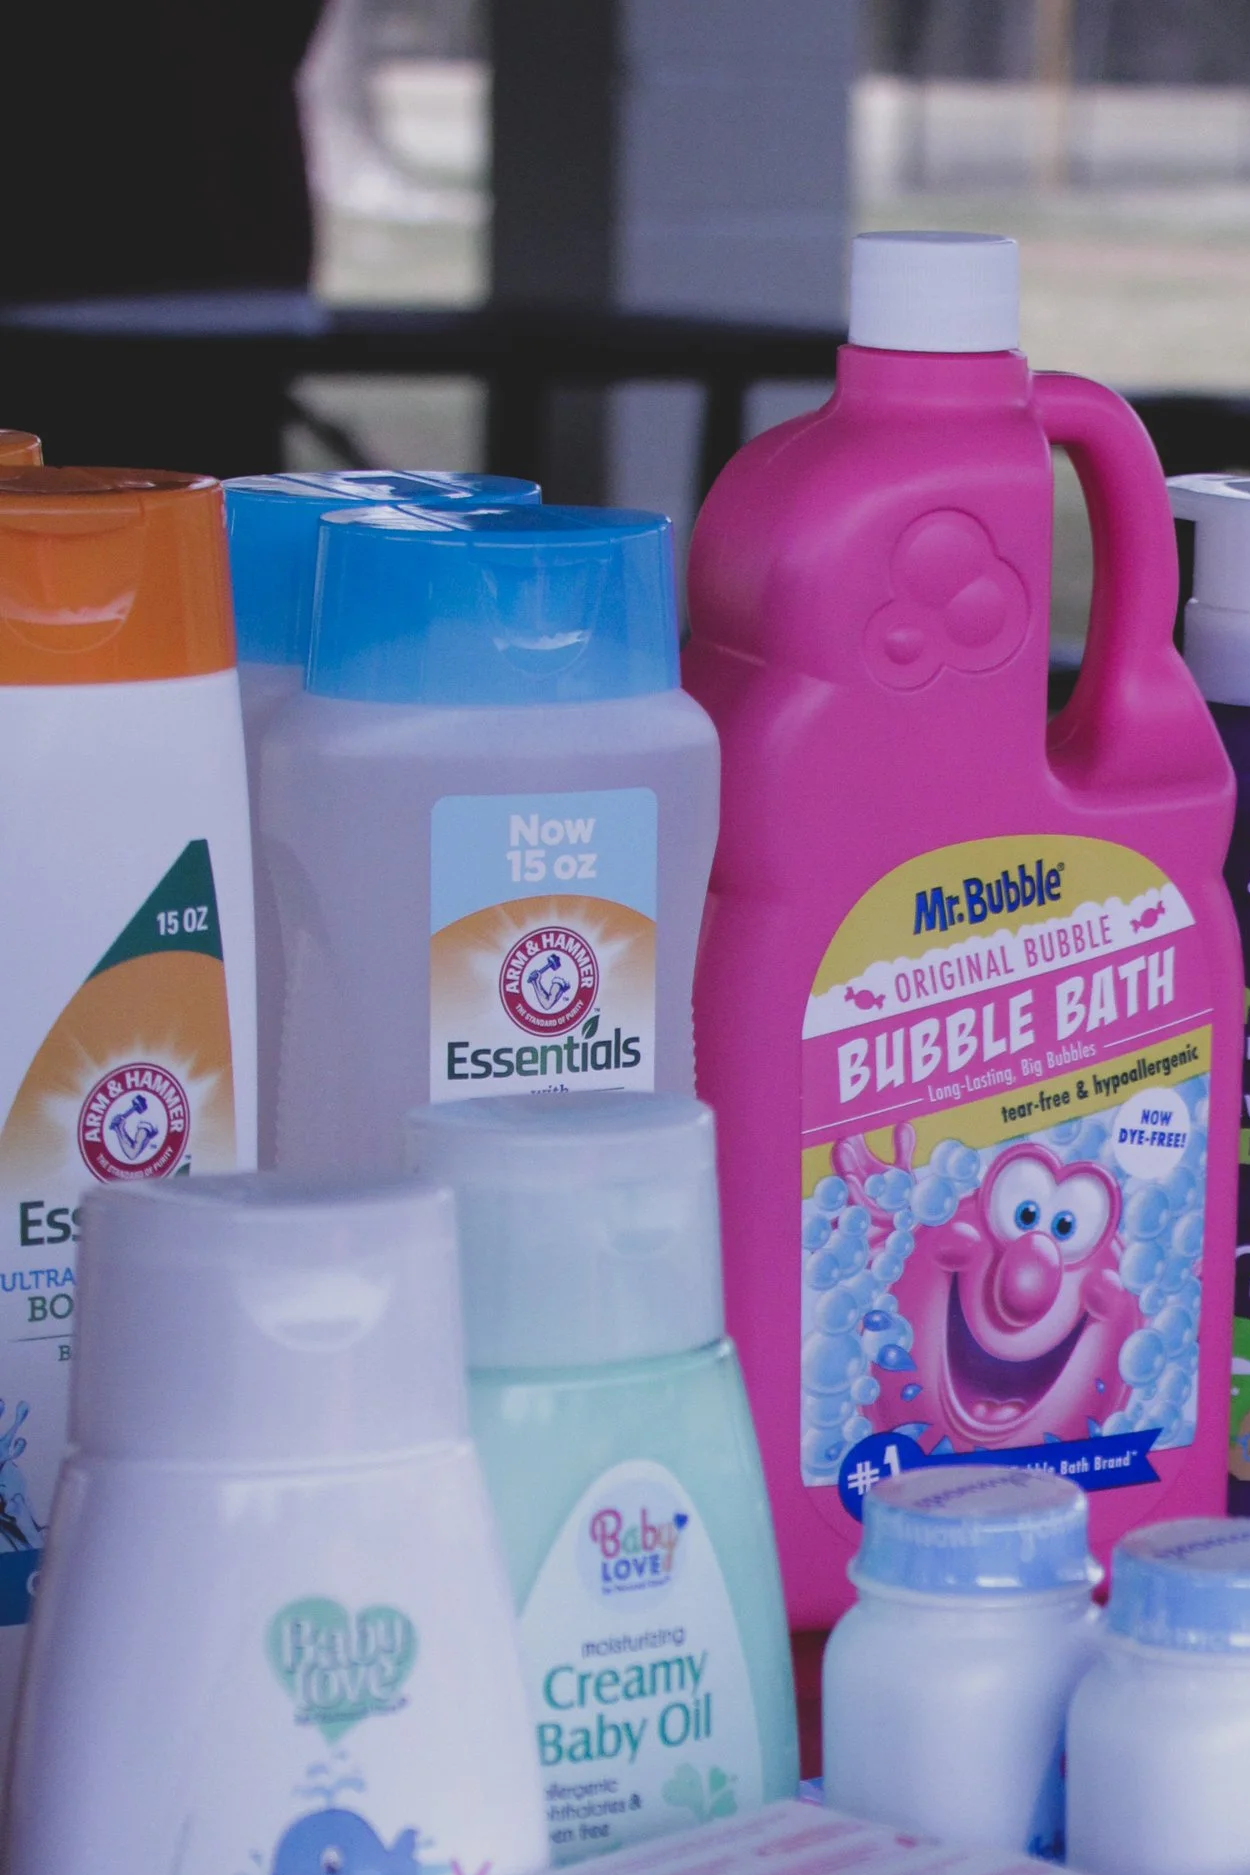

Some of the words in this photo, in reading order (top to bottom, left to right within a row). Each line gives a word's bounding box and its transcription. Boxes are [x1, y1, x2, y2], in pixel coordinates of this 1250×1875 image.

[509, 814, 596, 847] Now
[506, 850, 547, 882] 15
[553, 853, 598, 880] oz
[156, 910, 179, 936] 15
[183, 905, 209, 933] OZ
[506, 951, 527, 994] ARM
[525, 940, 540, 956] &
[541, 933, 593, 988] HAMMER
[894, 946, 1014, 1003] ORIGINAL
[1023, 915, 1114, 968] BUBBLE
[525, 1013, 557, 1027] STANDARD
[566, 1000, 585, 1021] PURITY
[837, 989, 1036, 1104] BUBBLE
[1055, 946, 1175, 1041] BATH
[447, 1028, 641, 1080] Essentials
[1021, 1059, 1043, 1077] Big
[1046, 1042, 1096, 1069] Bubbles
[1001, 1090, 1070, 1123] tear-free
[1076, 1080, 1089, 1099] &
[1093, 1044, 1199, 1096] hypoallergenic
[85, 1093, 110, 1142] ARM
[107, 1080, 123, 1098] &
[125, 1070, 184, 1132] HAMMER
[1140, 1109, 1174, 1127] NOW
[1118, 1128, 1187, 1149] DYE-FREE!
[1060, 1456, 1089, 1475] Bath
[1094, 1451, 1131, 1471] Brand
[588, 1504, 681, 1573] Baby
[601, 1553, 661, 1583] LOVE
[581, 1625, 686, 1659] moisturizing
[543, 1650, 708, 1711] Creamy
[537, 1713, 646, 1767] Baby
[658, 1692, 713, 1748] Oil
